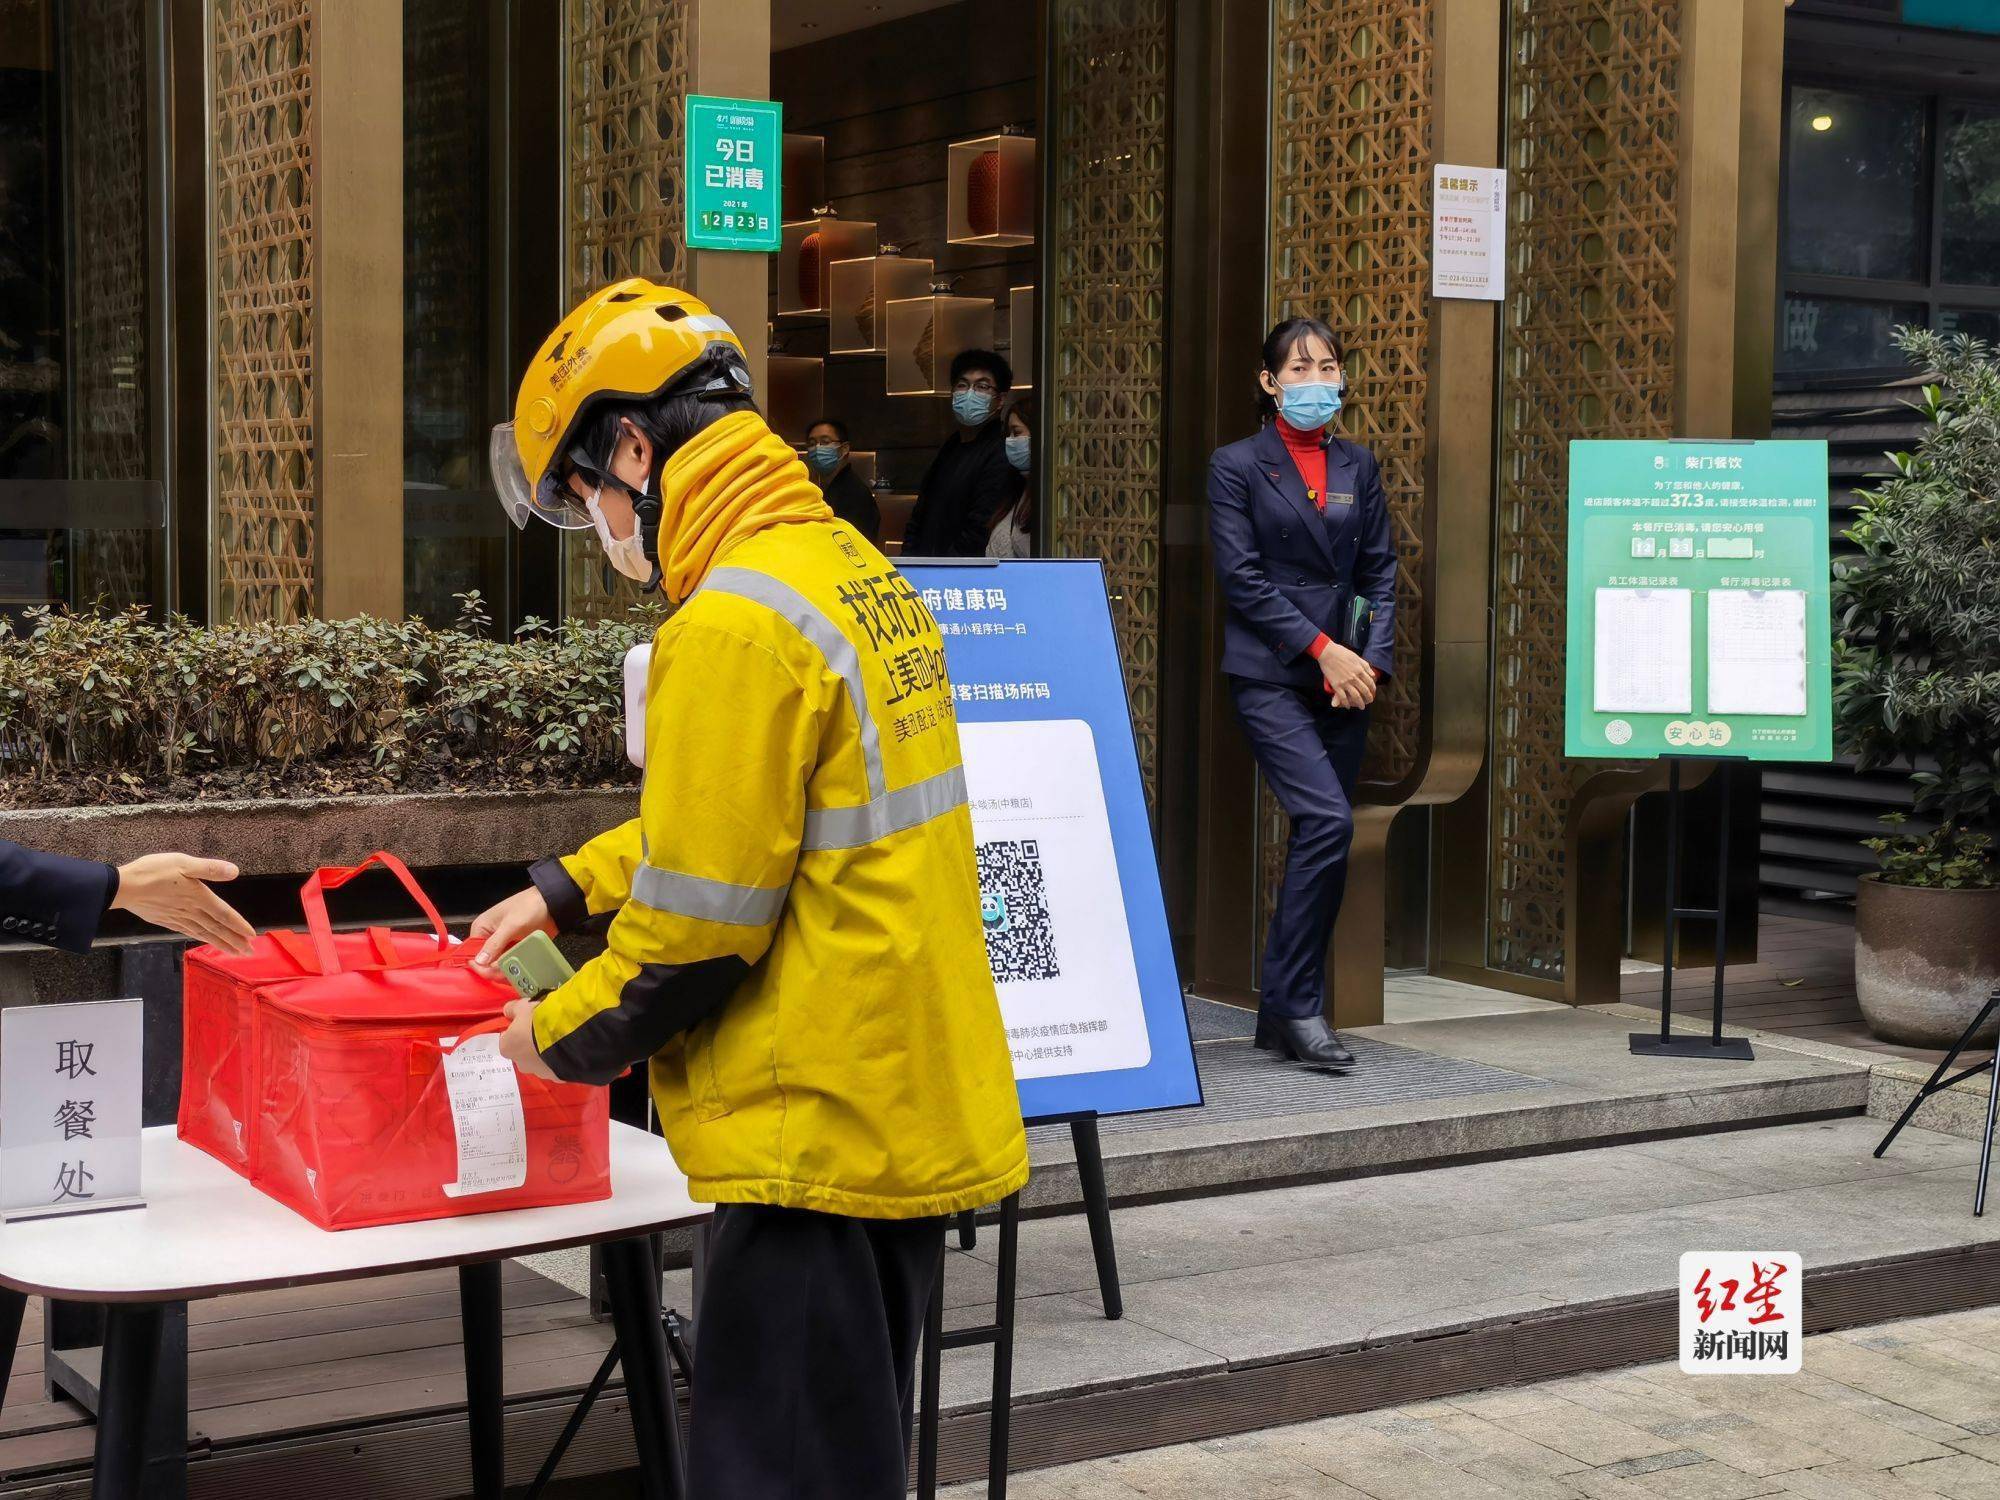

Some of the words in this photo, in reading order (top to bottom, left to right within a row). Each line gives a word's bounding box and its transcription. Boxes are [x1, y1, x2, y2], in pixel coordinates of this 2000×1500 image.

[716, 138, 754, 163] 今日
[705, 164, 764, 190] 已消毒
[723, 200, 749, 209] 2021年
[702, 213, 769, 230] 12月23日
[549, 345, 589, 389] 美团外卖
[1685, 456, 1742, 470] 柴门餐饮
[1668, 727, 1722, 741] 安心站
[52, 1039, 98, 1203] 取餐处
